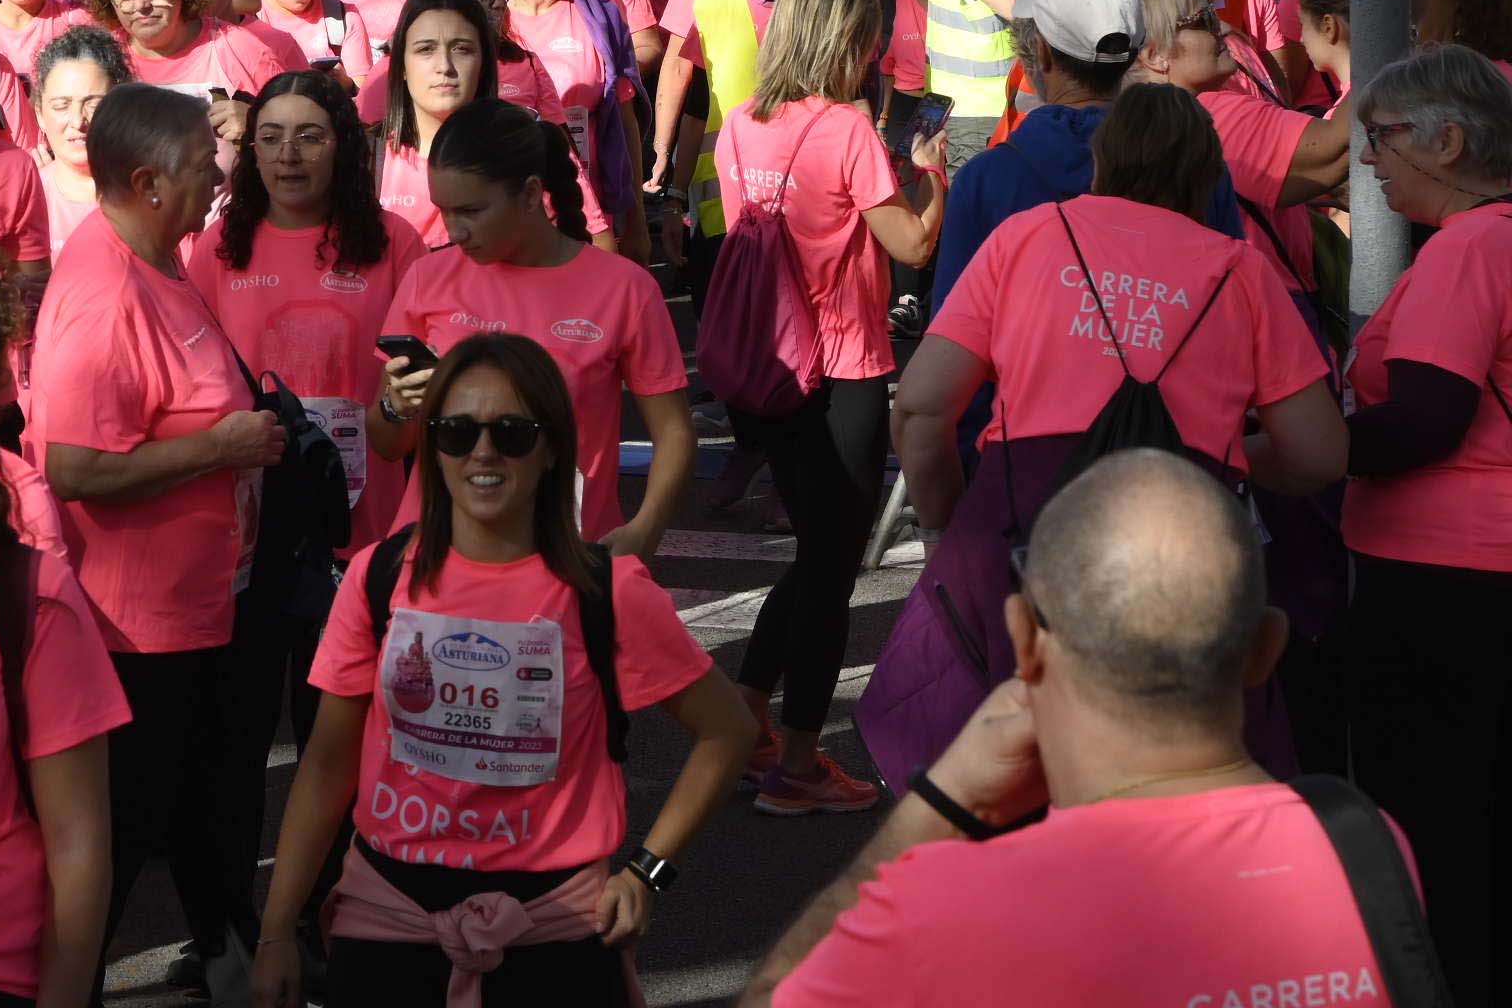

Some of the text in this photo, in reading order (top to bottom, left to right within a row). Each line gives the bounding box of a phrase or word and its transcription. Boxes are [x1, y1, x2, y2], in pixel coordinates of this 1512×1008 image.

[730, 163, 797, 190] CARRERA
[231, 274, 280, 291] OYSHO
[1060, 265, 1190, 311] CARRERA
[1079, 290, 1162, 325] DE LA
[449, 312, 506, 331] OYSHO
[554, 325, 602, 340] ASTURIANA
[1068, 314, 1165, 352] MUJER
[439, 642, 504, 665] ASTURIANA
[518, 645, 551, 656] SUMA
[439, 682, 499, 709] 016
[444, 711, 492, 730] 22365
[480, 735, 513, 750] MUJER
[489, 761, 545, 775] Santander
[371, 780, 532, 846] DORSAL
[1187, 966, 1379, 1008] CARRERA
